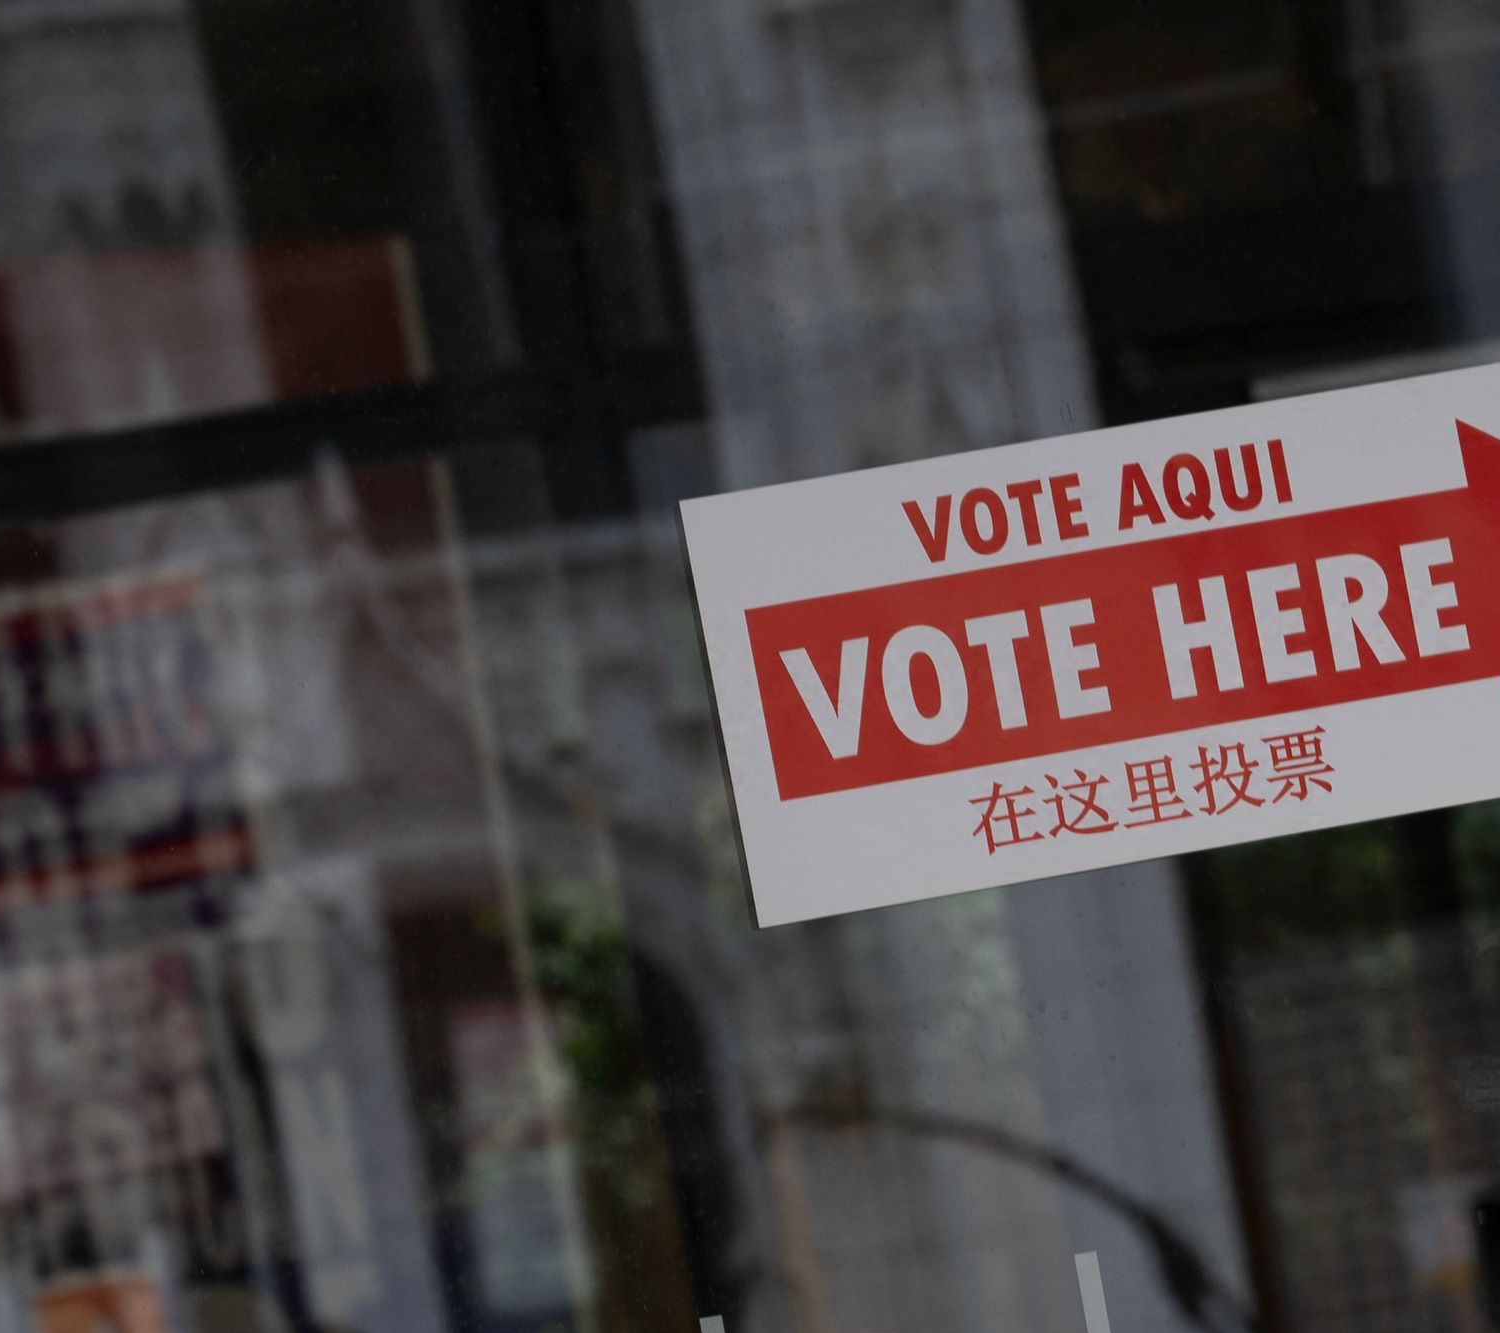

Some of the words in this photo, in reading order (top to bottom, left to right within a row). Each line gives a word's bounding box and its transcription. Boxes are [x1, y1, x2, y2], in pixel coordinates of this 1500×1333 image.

[902, 472, 1090, 563] VOTE
[1118, 439, 1294, 530] AQUI
[780, 597, 1112, 760] VOTE
[1152, 537, 1470, 701] HERE
[970, 726, 1336, 855] 在这里投票
